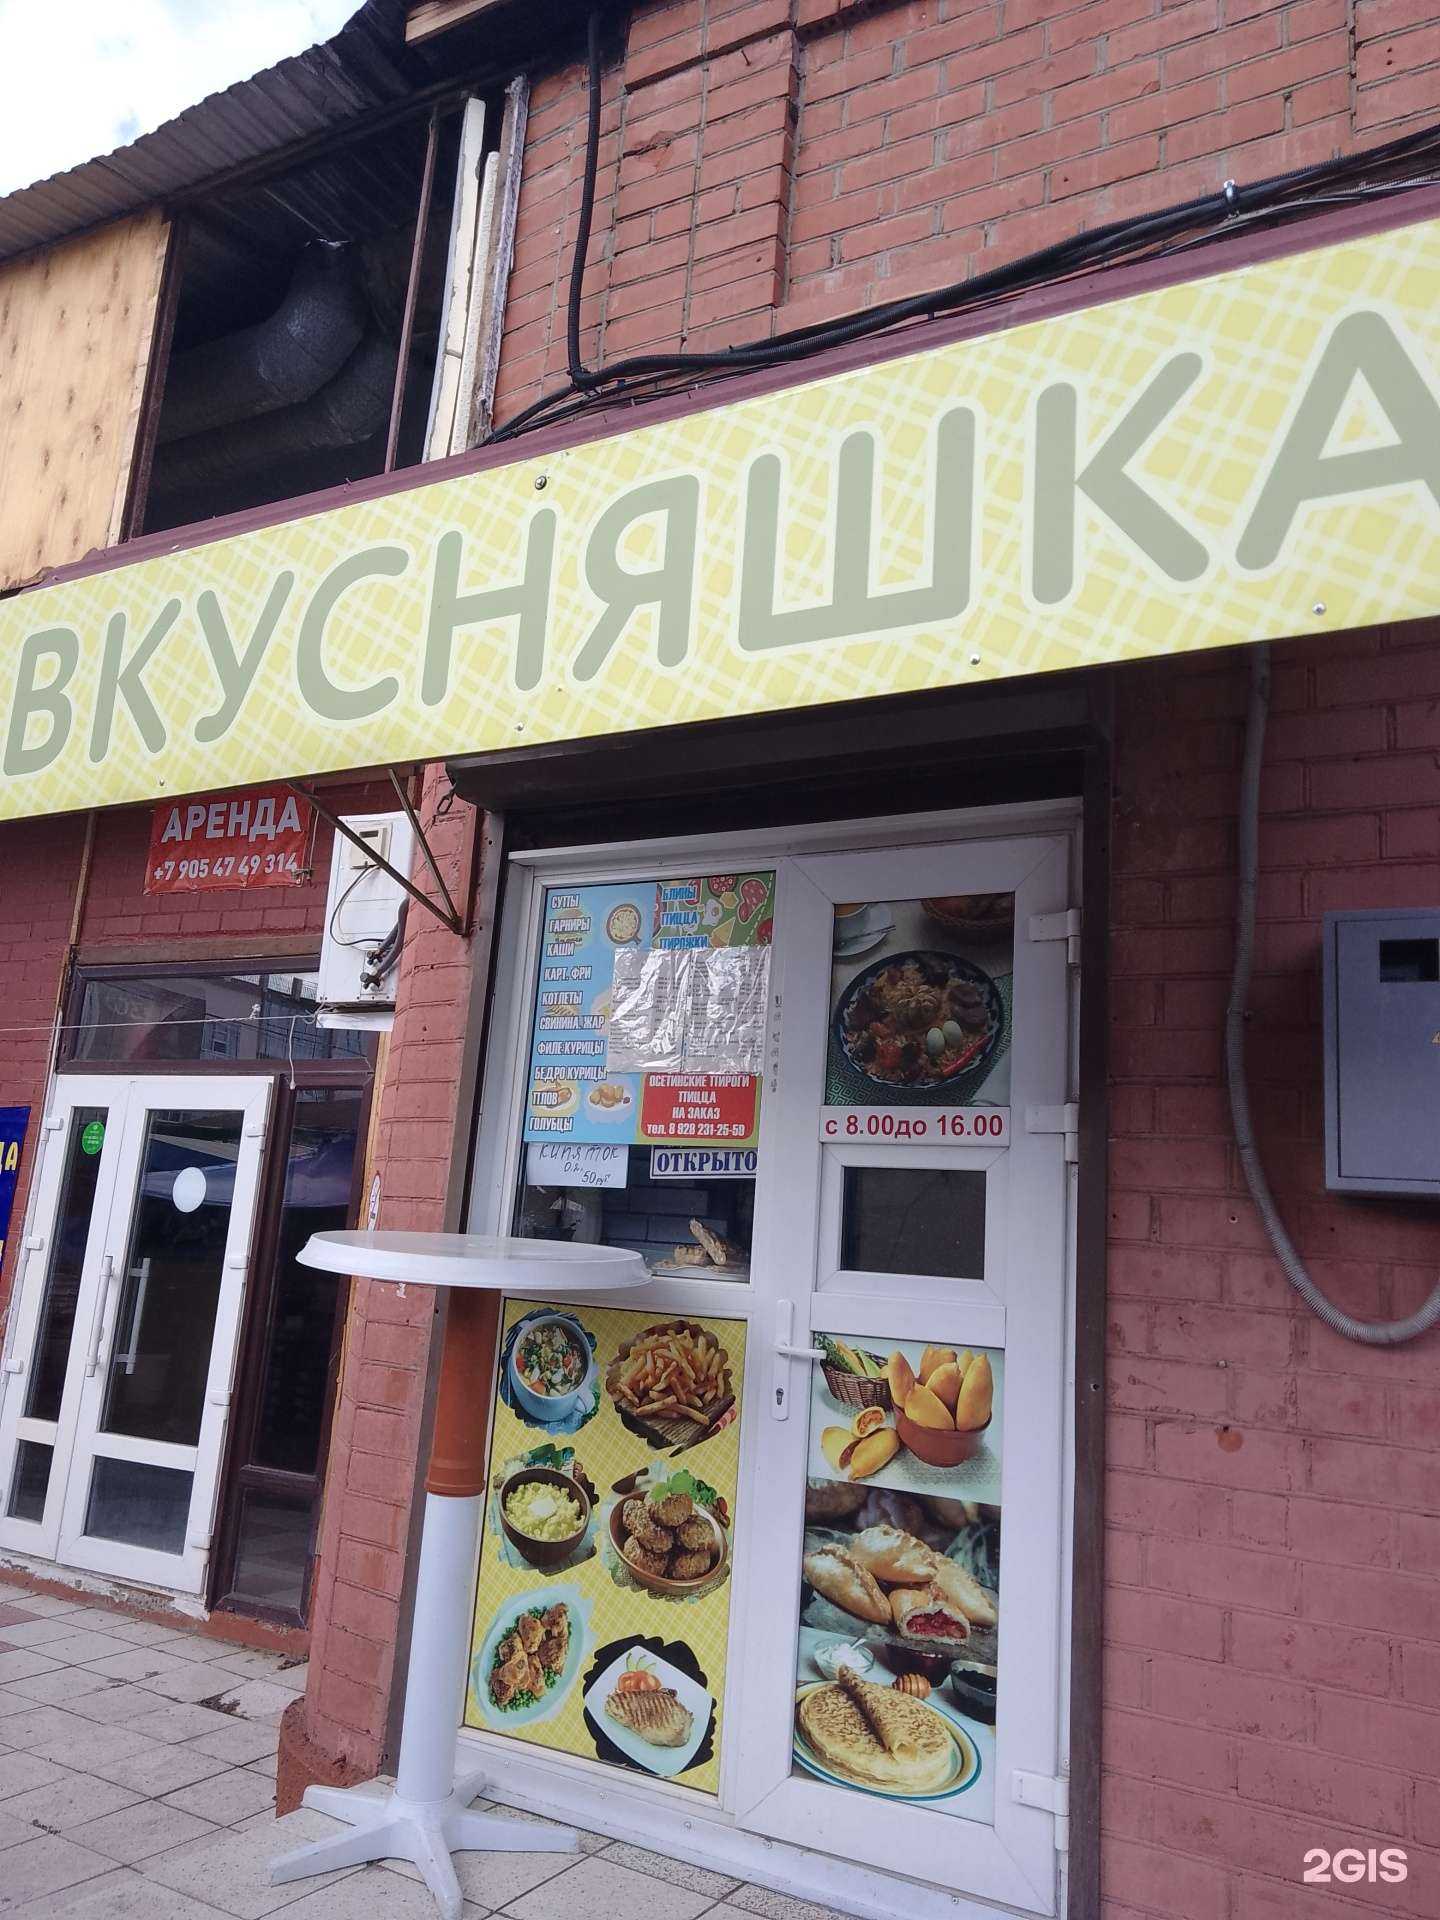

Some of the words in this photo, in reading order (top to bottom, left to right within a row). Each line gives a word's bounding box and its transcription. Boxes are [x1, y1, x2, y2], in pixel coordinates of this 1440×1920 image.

[3, 310, 1440, 777] ВКУСНЯШКА
[161, 796, 301, 843] АРЕНДА
[154, 861, 176, 881] +7
[178, 858, 210, 880] 905
[212, 857, 236, 877] 47
[238, 855, 261, 876] 49
[264, 852, 298, 874] 314
[549, 917, 591, 933] ГАРНИРЫ
[661, 911, 699, 927] ПИЦЦА
[546, 942, 575, 957] КАШИ
[544, 967, 569, 981] КАРТ.
[571, 965, 592, 980] ФРИ
[541, 991, 583, 1006] КОТЛЕТЫ
[583, 1014, 605, 1029] ЖАР
[537, 1041, 562, 1055] ФИЛЕ
[564, 1040, 604, 1056] КУРИЦЫ
[534, 1066, 566, 1082] БЕДРО
[567, 1066, 607, 1082] КУРИЦЫ
[649, 1075, 707, 1087] ОСЕТИНСКИЕ
[710, 1075, 749, 1087] ПИРОГИ
[532, 1091, 558, 1105] ПЛОВ
[678, 1091, 716, 1104] ПИЦЦА
[672, 1107, 685, 1119] НА
[688, 1107, 720, 1119] ЗАКАЗ
[529, 1116, 573, 1133] ГОЛУБЦЫ
[668, 1123, 676, 1135] 8
[937, 1114, 1003, 1136] 16.00
[657, 1151, 758, 1172] ОТКРЫТО
